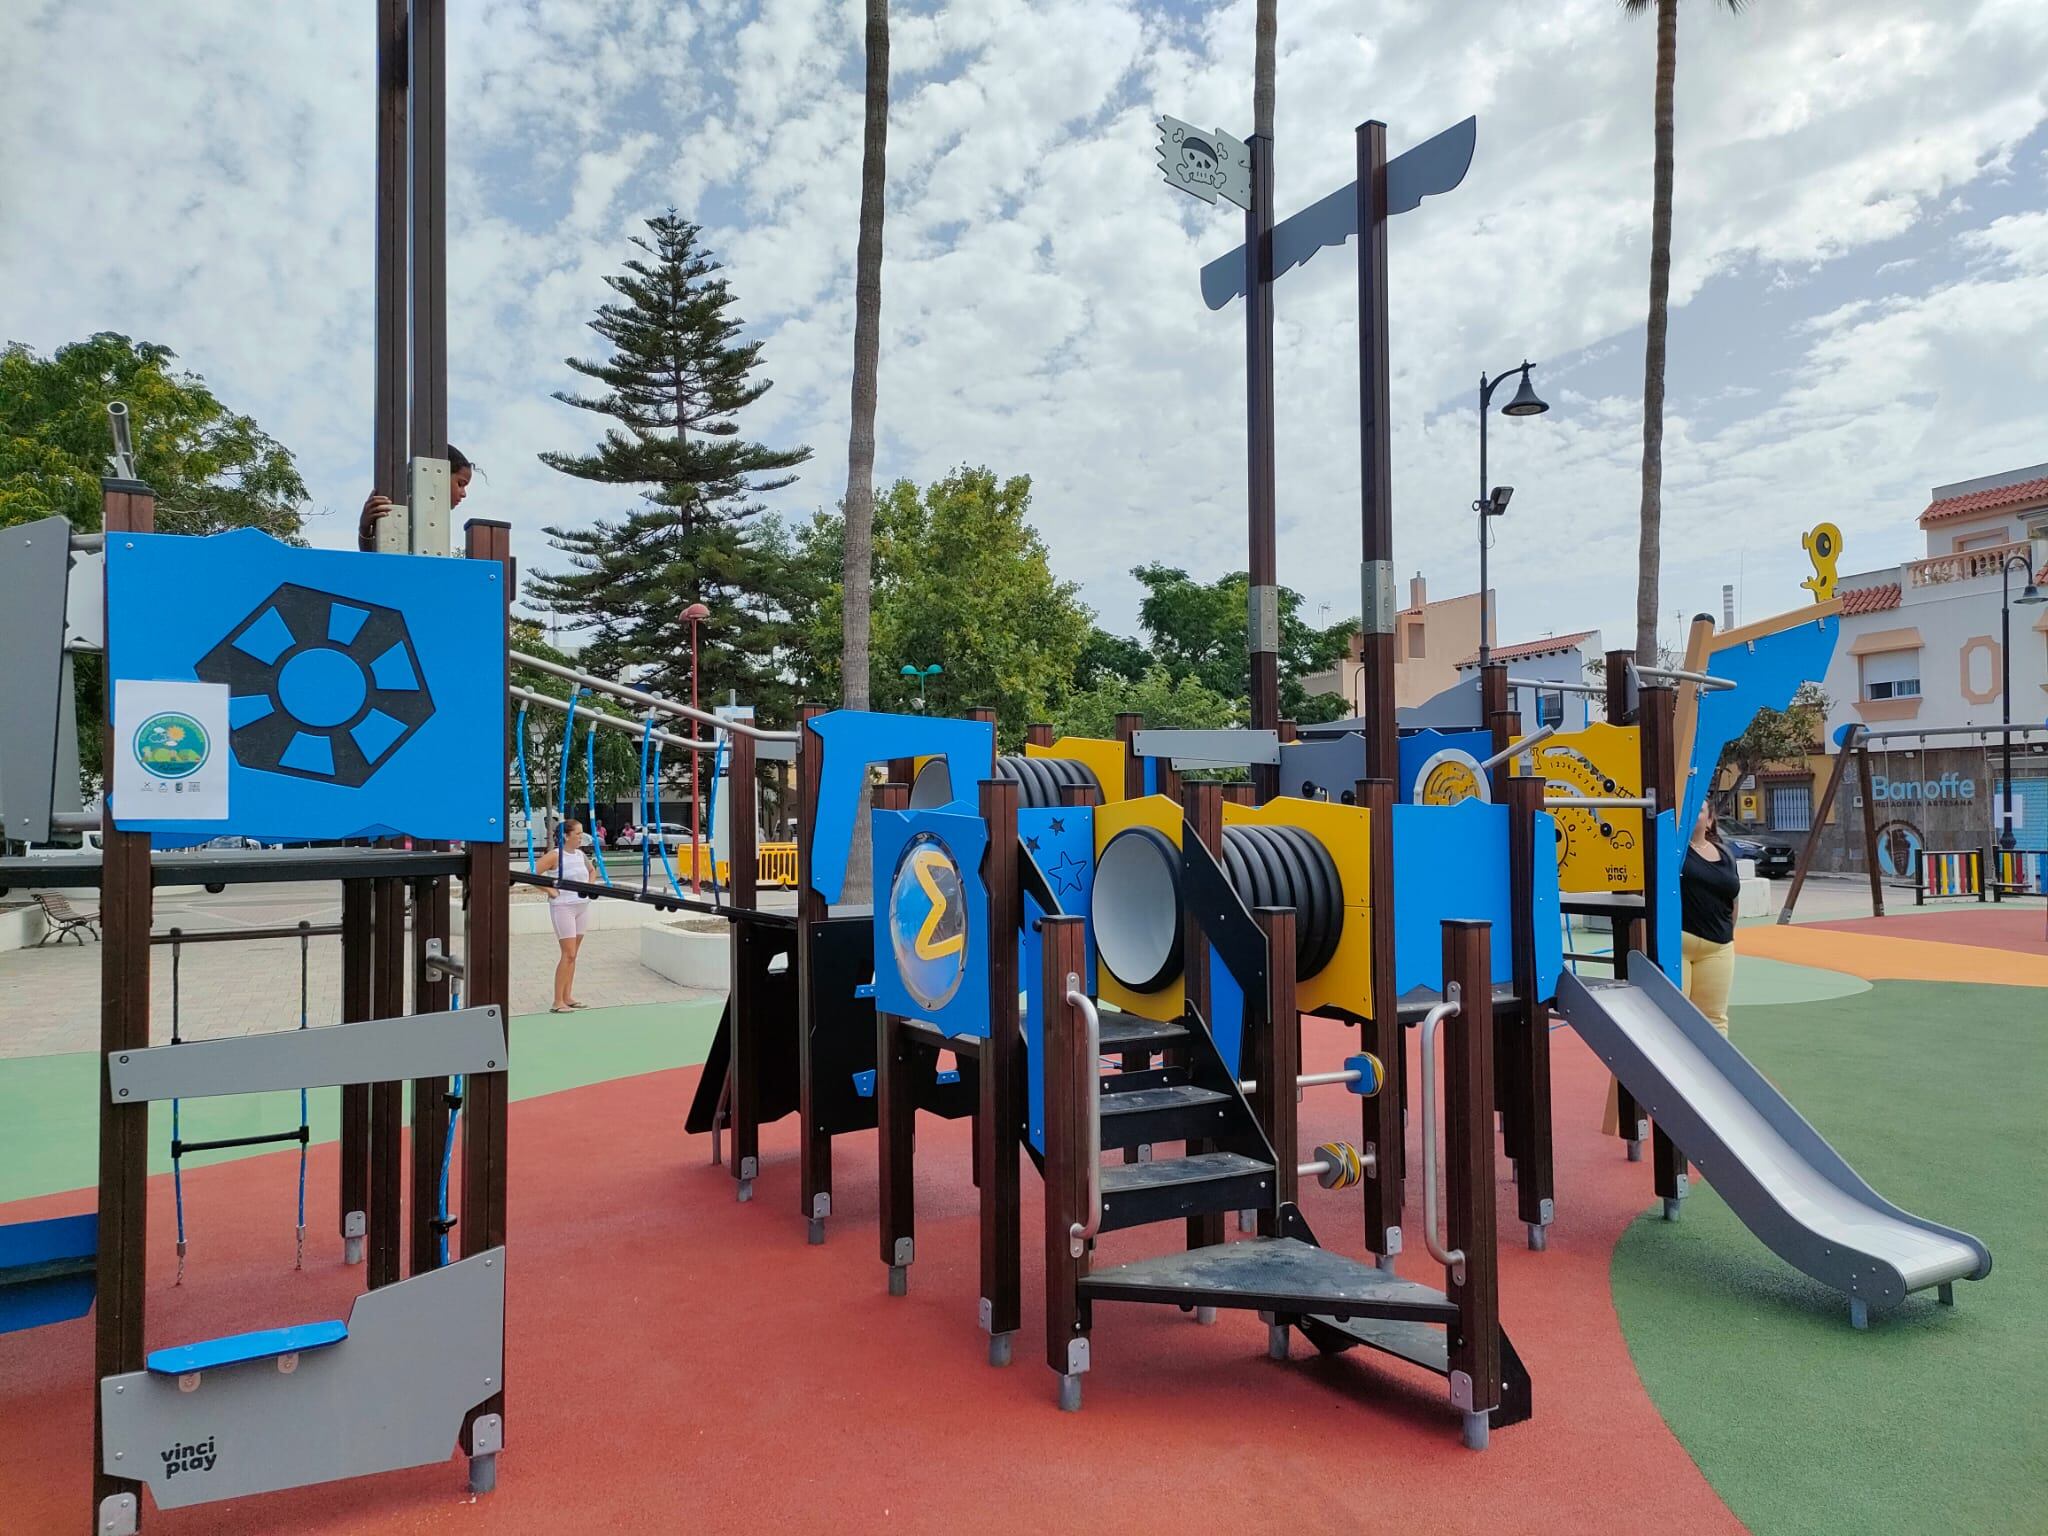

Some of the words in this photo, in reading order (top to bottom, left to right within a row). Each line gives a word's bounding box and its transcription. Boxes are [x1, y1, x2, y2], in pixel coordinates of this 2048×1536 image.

[1872, 772, 1976, 800] Banoffe
[1605, 864, 1627, 874] vinci
[1607, 873, 1628, 883] play
[160, 1435, 215, 1462] vinci
[166, 1453, 217, 1480] play
